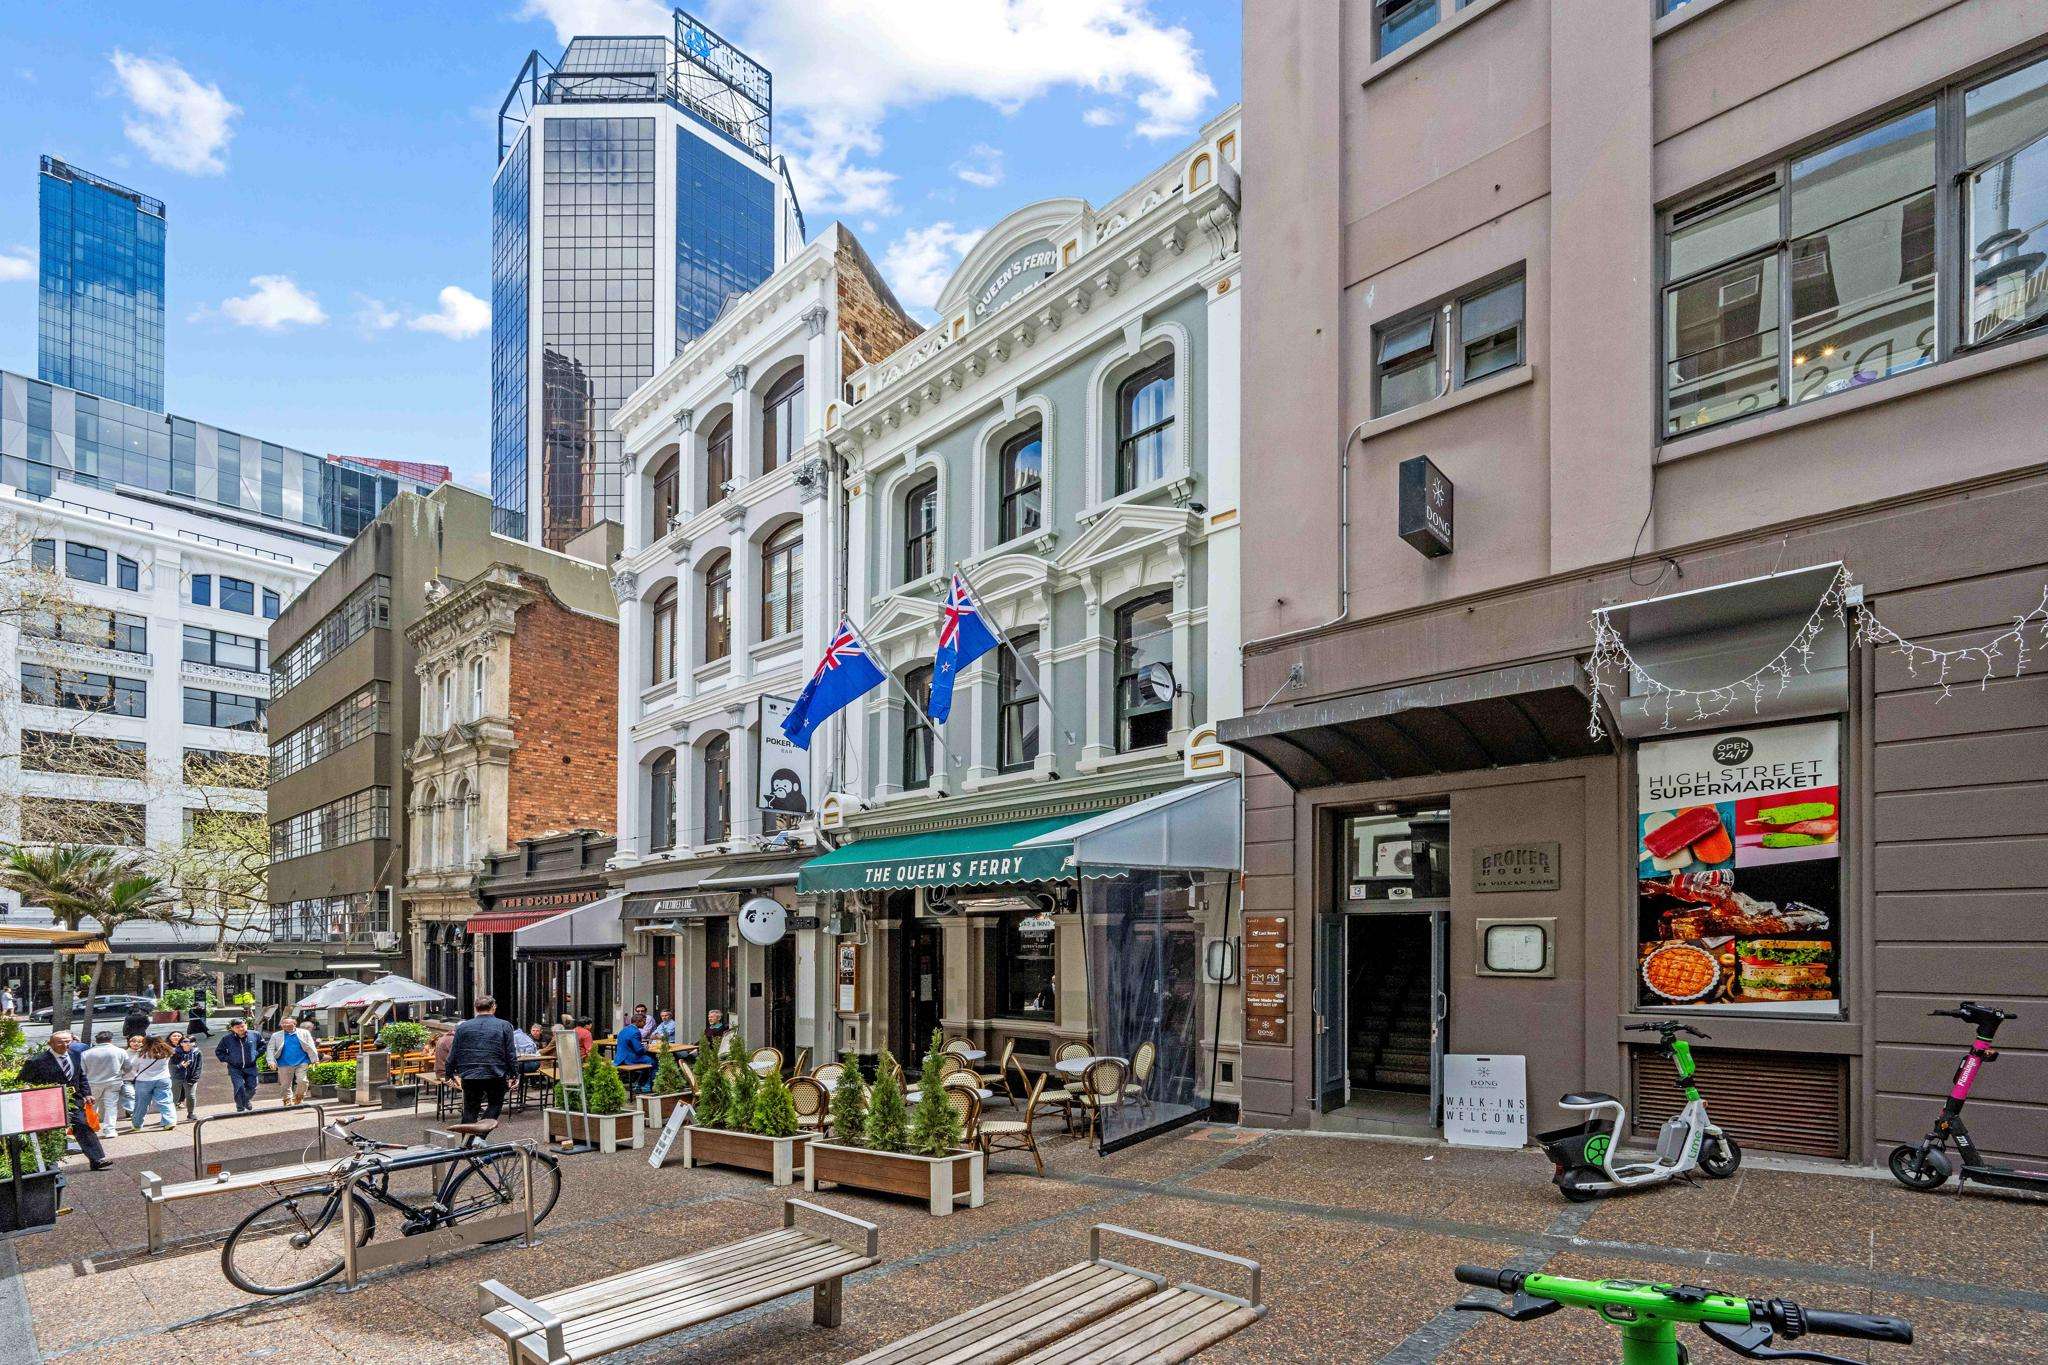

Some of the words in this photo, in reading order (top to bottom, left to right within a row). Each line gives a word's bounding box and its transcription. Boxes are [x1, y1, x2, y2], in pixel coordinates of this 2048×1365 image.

[975, 261, 1022, 315] QUEEN'S
[1426, 505, 1450, 536] DONG
[765, 736, 791, 747] POKER
[1717, 741, 1749, 751] OPEN
[1717, 749, 1749, 760] 24/7
[1650, 771, 1711, 788] HIGH
[1720, 759, 1822, 782] STREET
[1650, 774, 1822, 800] SUPERMARKET
[865, 867, 892, 882] THE
[896, 861, 962, 882] QUEEN'S
[968, 856, 1024, 877] FERRY
[1482, 849, 1549, 869] BROKER
[1482, 866, 1551, 876] HOUSE
[502, 897, 521, 908] THE
[526, 891, 600, 906] OCCIDENTAL
[1957, 1057, 1976, 1087] Flamingo
[1446, 1096, 1525, 1109] WALK-INS
[1446, 1111, 1525, 1125] WELCOME
[1687, 1130, 1702, 1159] Lime
